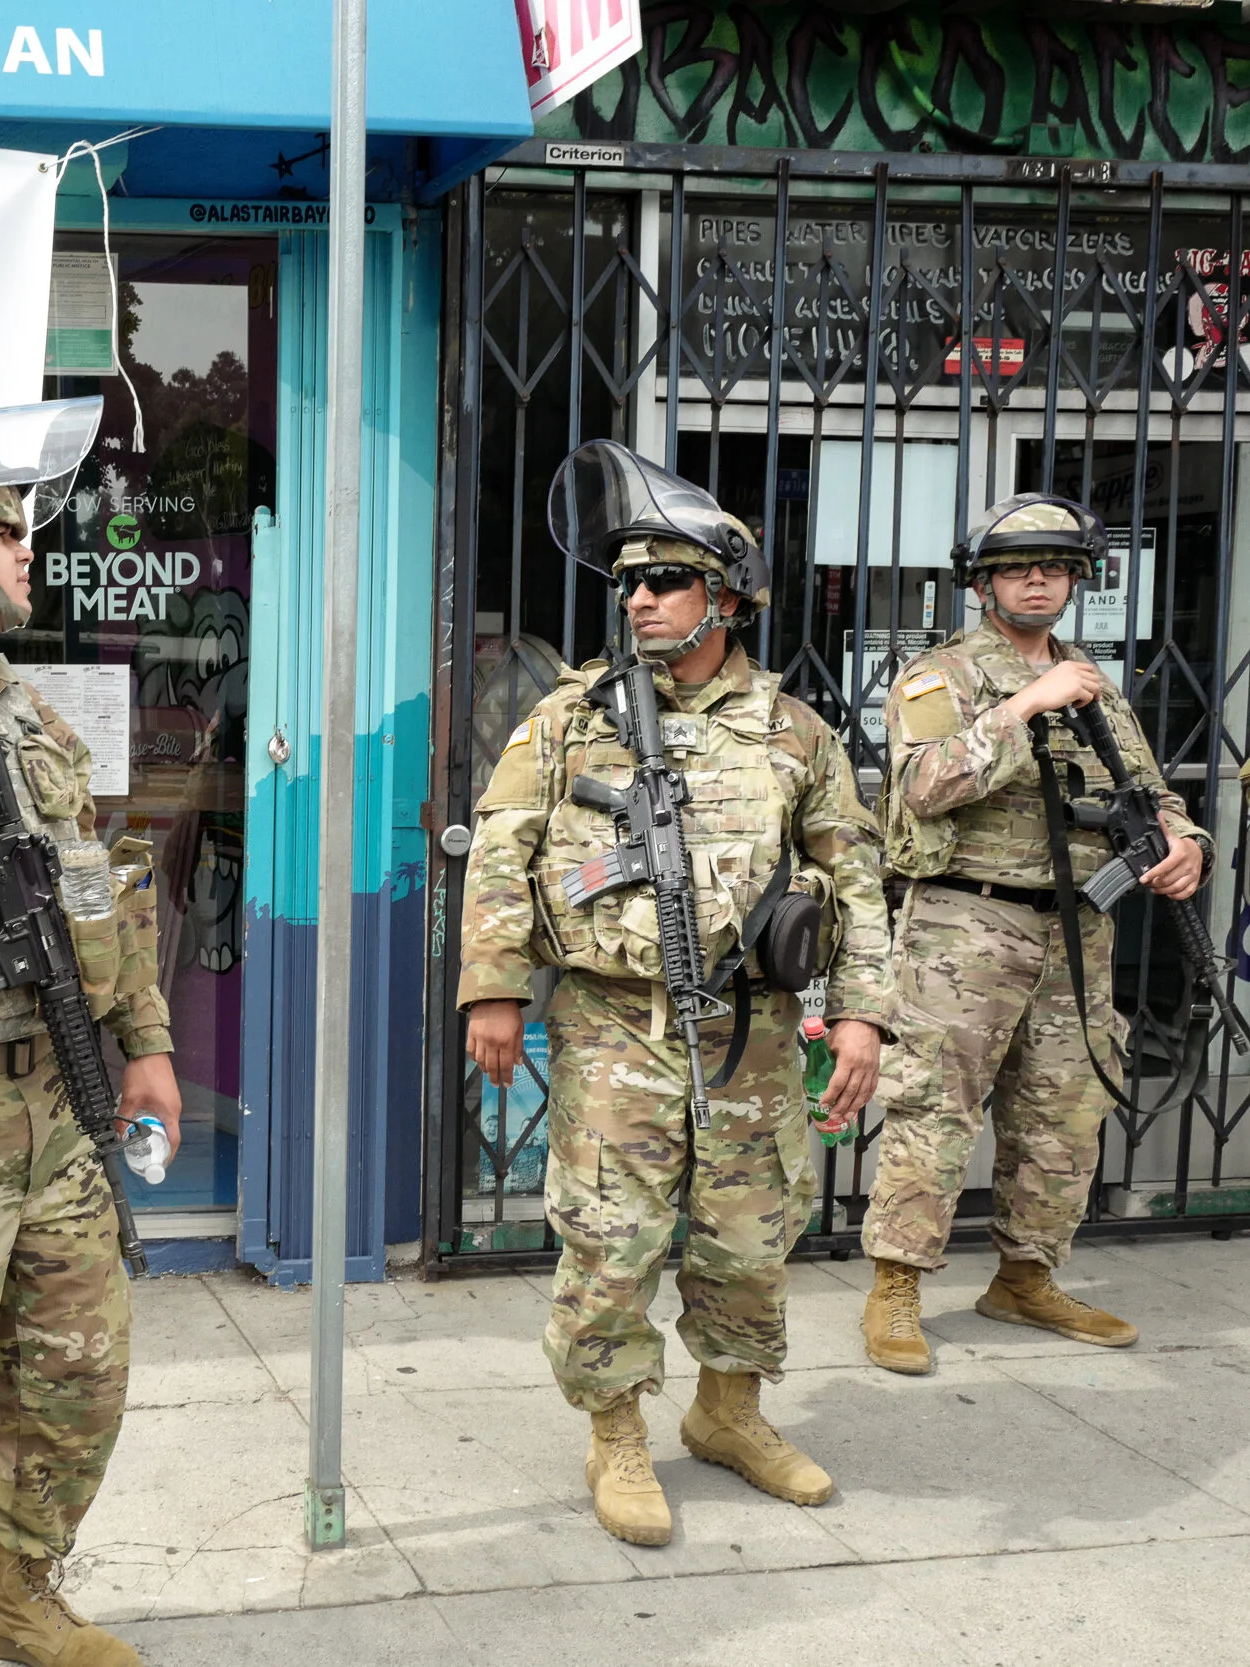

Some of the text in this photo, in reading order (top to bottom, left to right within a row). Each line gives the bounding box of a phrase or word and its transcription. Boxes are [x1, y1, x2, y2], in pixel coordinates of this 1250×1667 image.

[549, 146, 622, 161] Criterion
[189, 203, 377, 225] @ALASTAIRBAYO
[698, 218, 762, 246] PIPES
[884, 222, 950, 248] IPES
[972, 226, 1135, 256] VAPORZERS
[110, 497, 195, 514] SERVING
[46, 551, 201, 586] BEYOND
[73, 587, 174, 621] MEAT
[1088, 596, 1116, 605] AND
